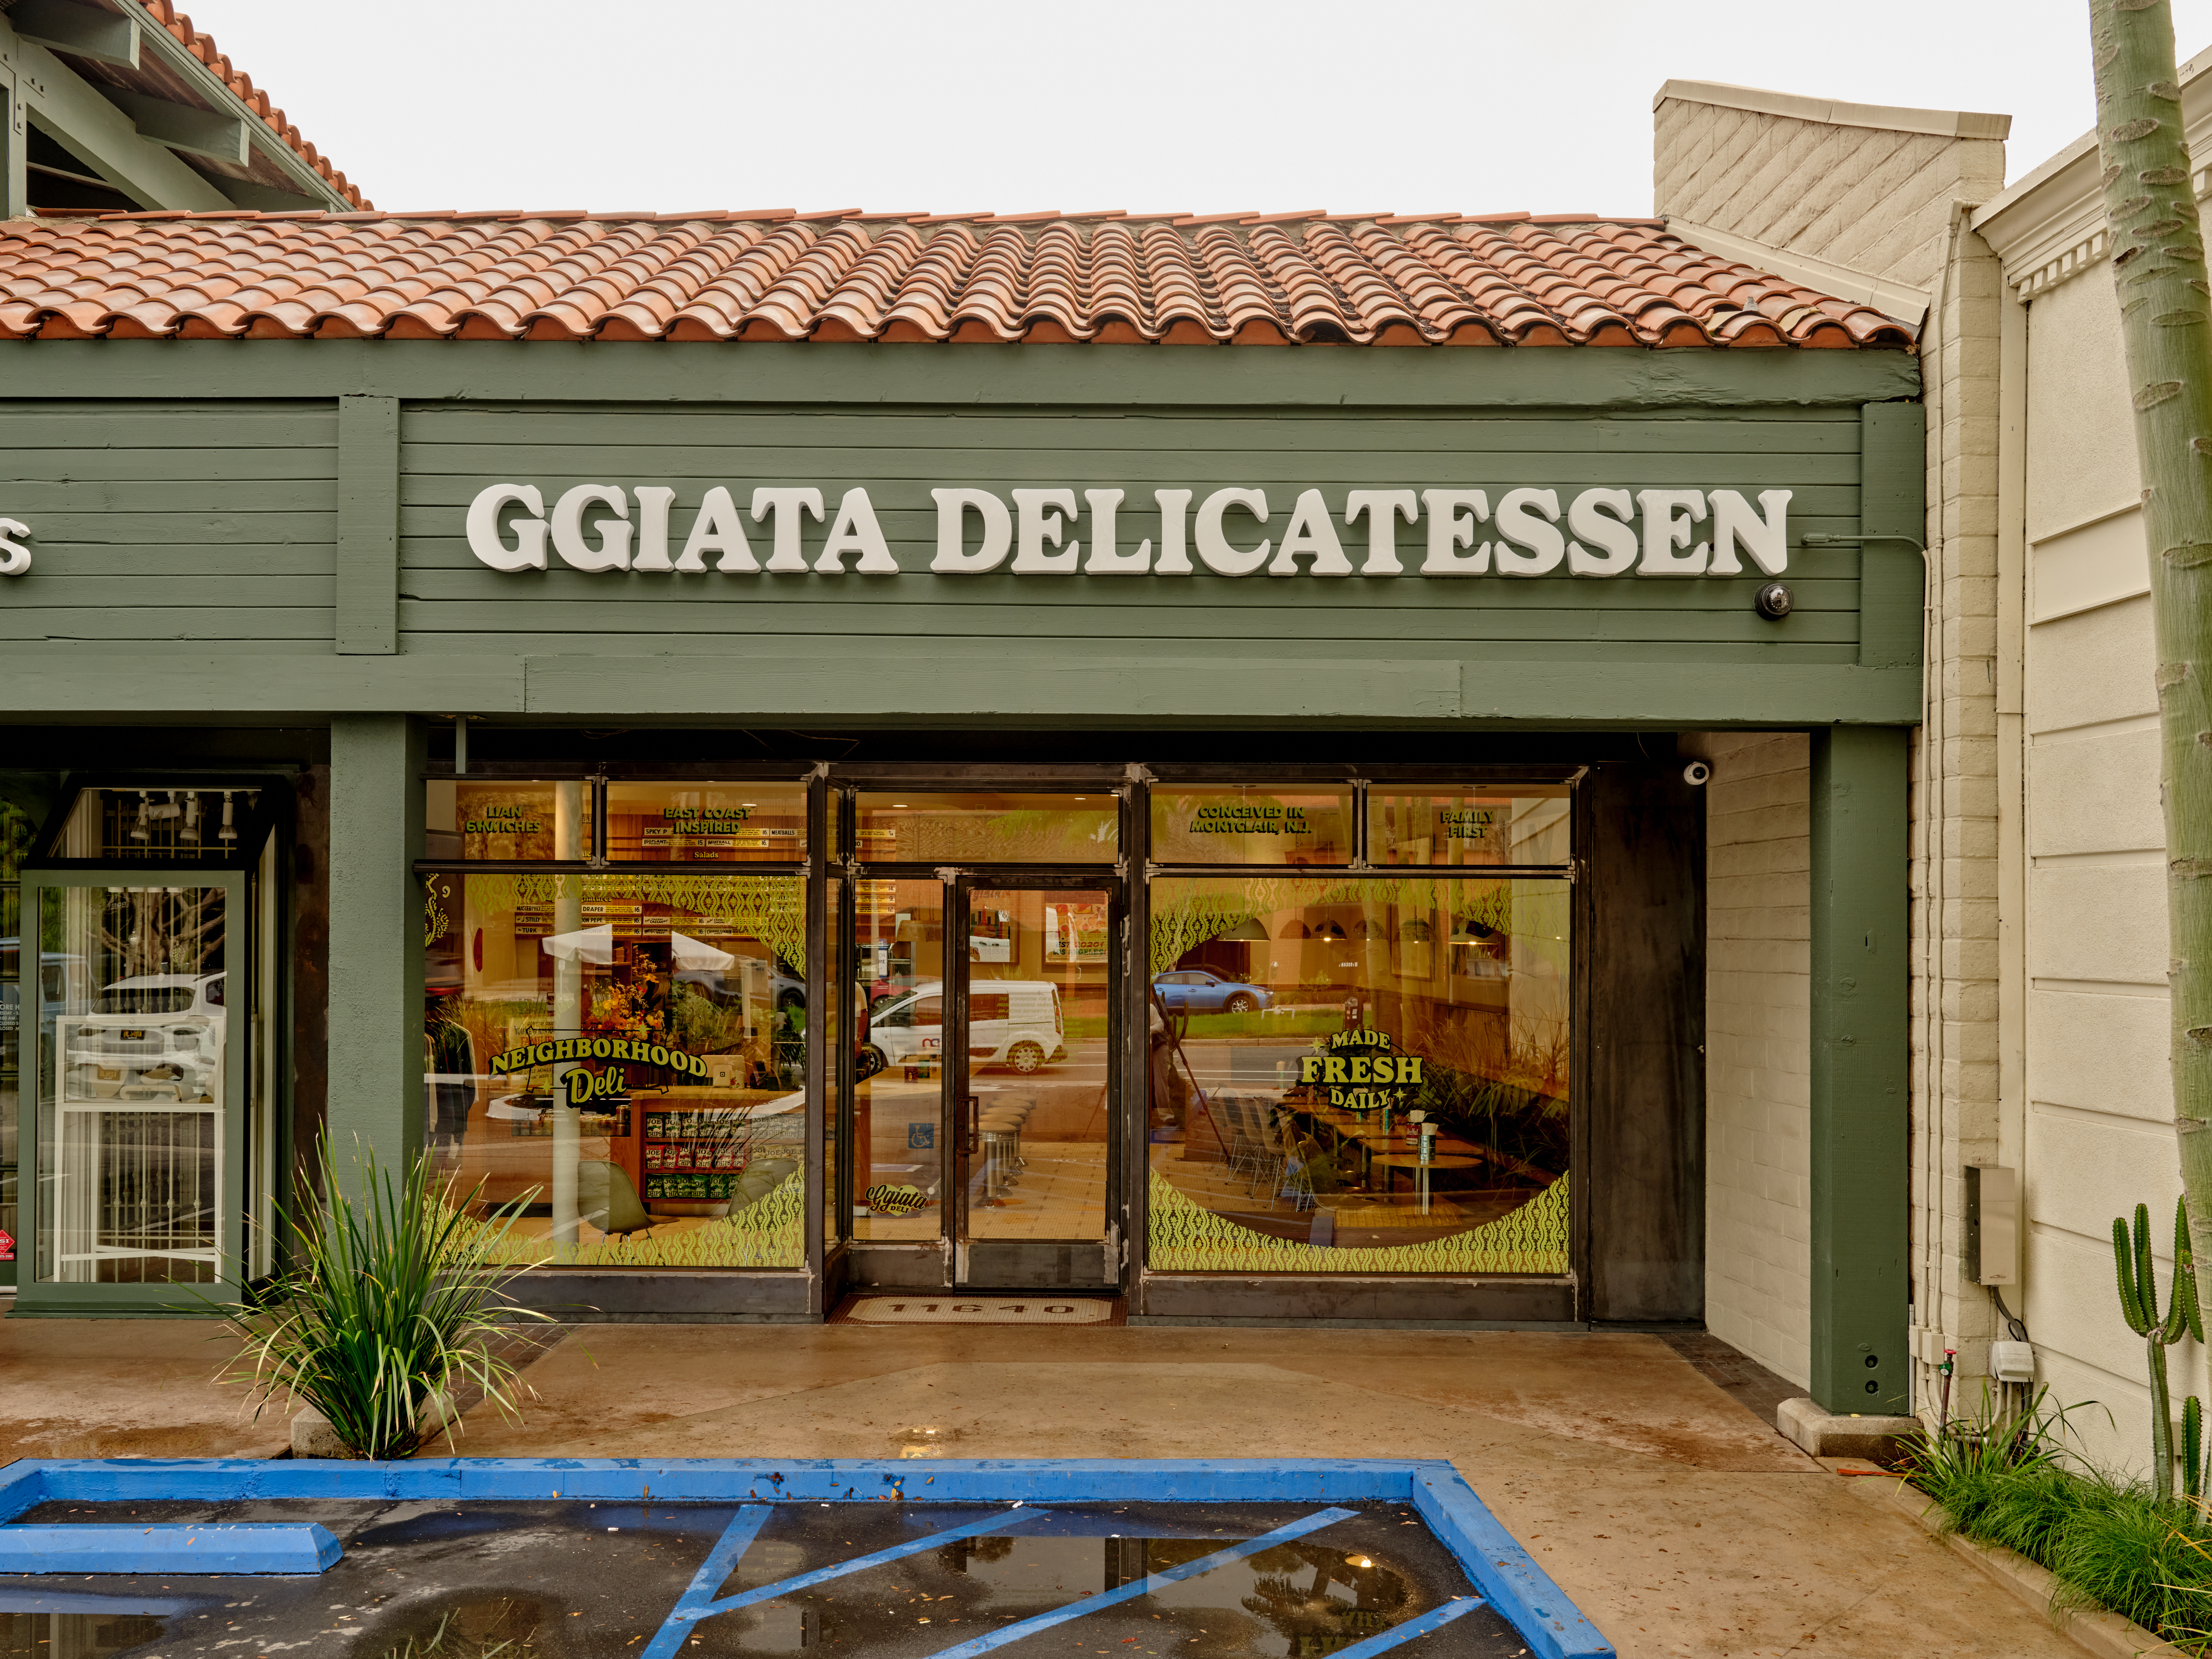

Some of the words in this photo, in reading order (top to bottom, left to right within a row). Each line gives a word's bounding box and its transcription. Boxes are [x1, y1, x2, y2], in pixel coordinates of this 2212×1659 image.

[466, 483, 899, 575] GGIATA
[930, 487, 1793, 578] DELICATESSEN
[664, 807, 700, 820] EAST
[702, 807, 751, 820] COAST
[1198, 806, 1284, 818] CONCEIVED
[1287, 807, 1305, 818] IN
[1441, 811, 1493, 823] FAMILY
[674, 822, 741, 834] INSPIRED
[1190, 821, 1281, 834] MONTCLAIR,
[1285, 821, 1312, 833] N.J.
[1448, 826, 1488, 838] FIRST
[1330, 1029, 1391, 1052] MADE
[489, 1038, 707, 1078] NEIGHBORHOOD
[1298, 1056, 1423, 1084] FRESH
[561, 1066, 627, 1107] Deli
[1329, 1088, 1391, 1109] DAILY
[865, 1185, 927, 1212] Ggiata
[888, 1304, 1074, 1313] 11640
